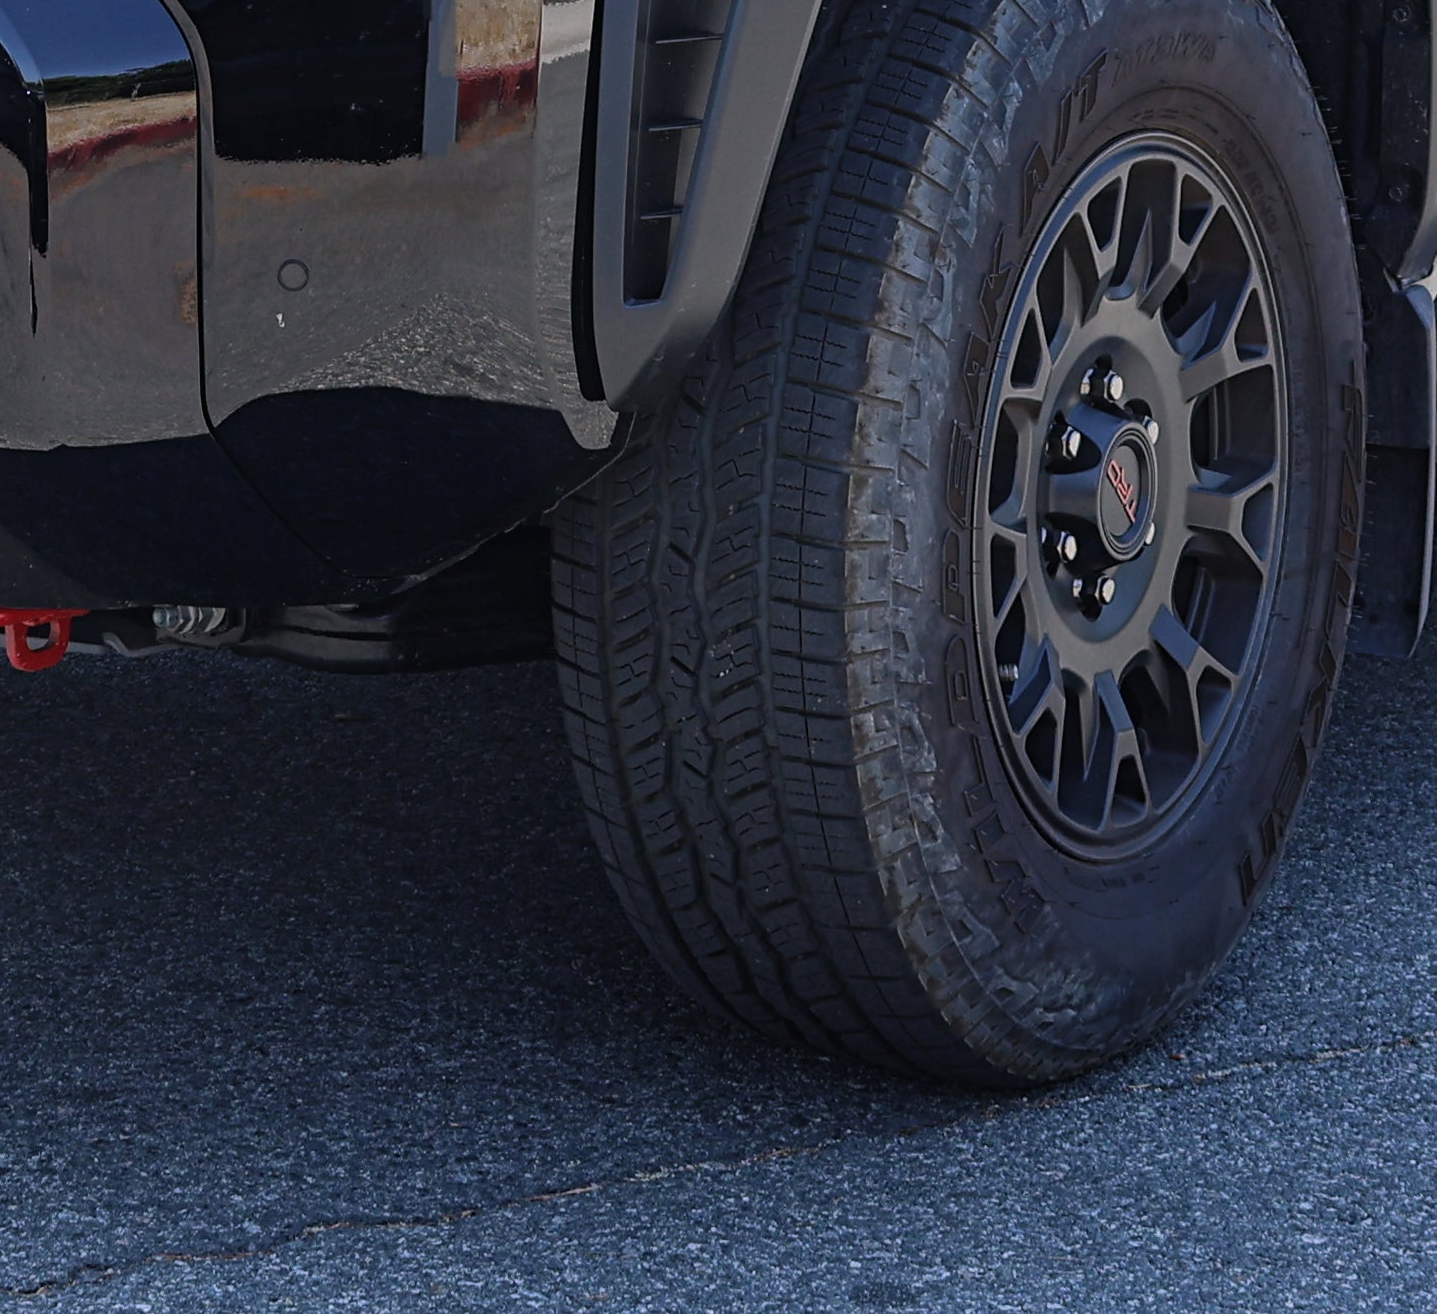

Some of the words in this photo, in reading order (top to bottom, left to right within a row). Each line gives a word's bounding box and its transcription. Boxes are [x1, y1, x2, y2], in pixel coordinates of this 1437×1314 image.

[941, 223, 1049, 934] WILDPEAK
[1107, 458, 1137, 524] TRD
[1237, 362, 1362, 908] FALKEN
